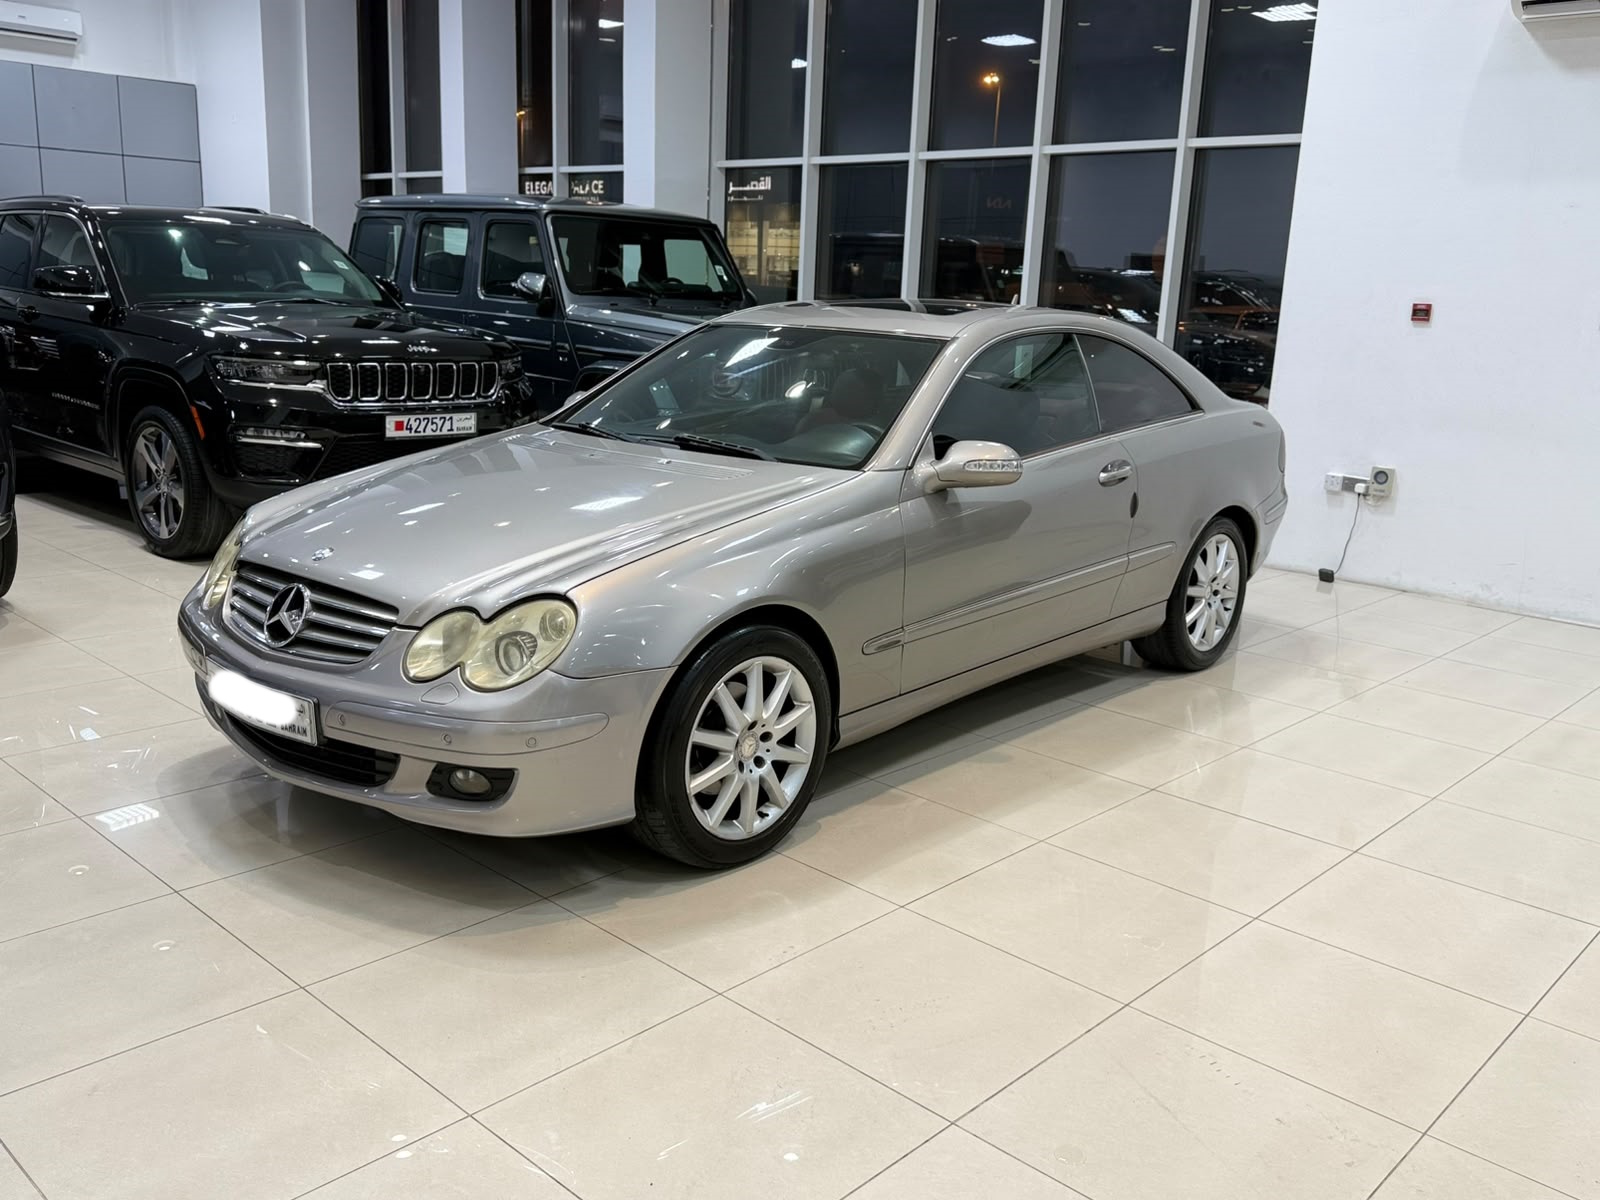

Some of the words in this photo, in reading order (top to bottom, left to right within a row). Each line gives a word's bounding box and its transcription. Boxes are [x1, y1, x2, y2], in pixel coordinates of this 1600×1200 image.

[525, 181, 554, 195] ELEGA
[407, 344, 430, 353] Jeep
[405, 416, 454, 434] 427571
